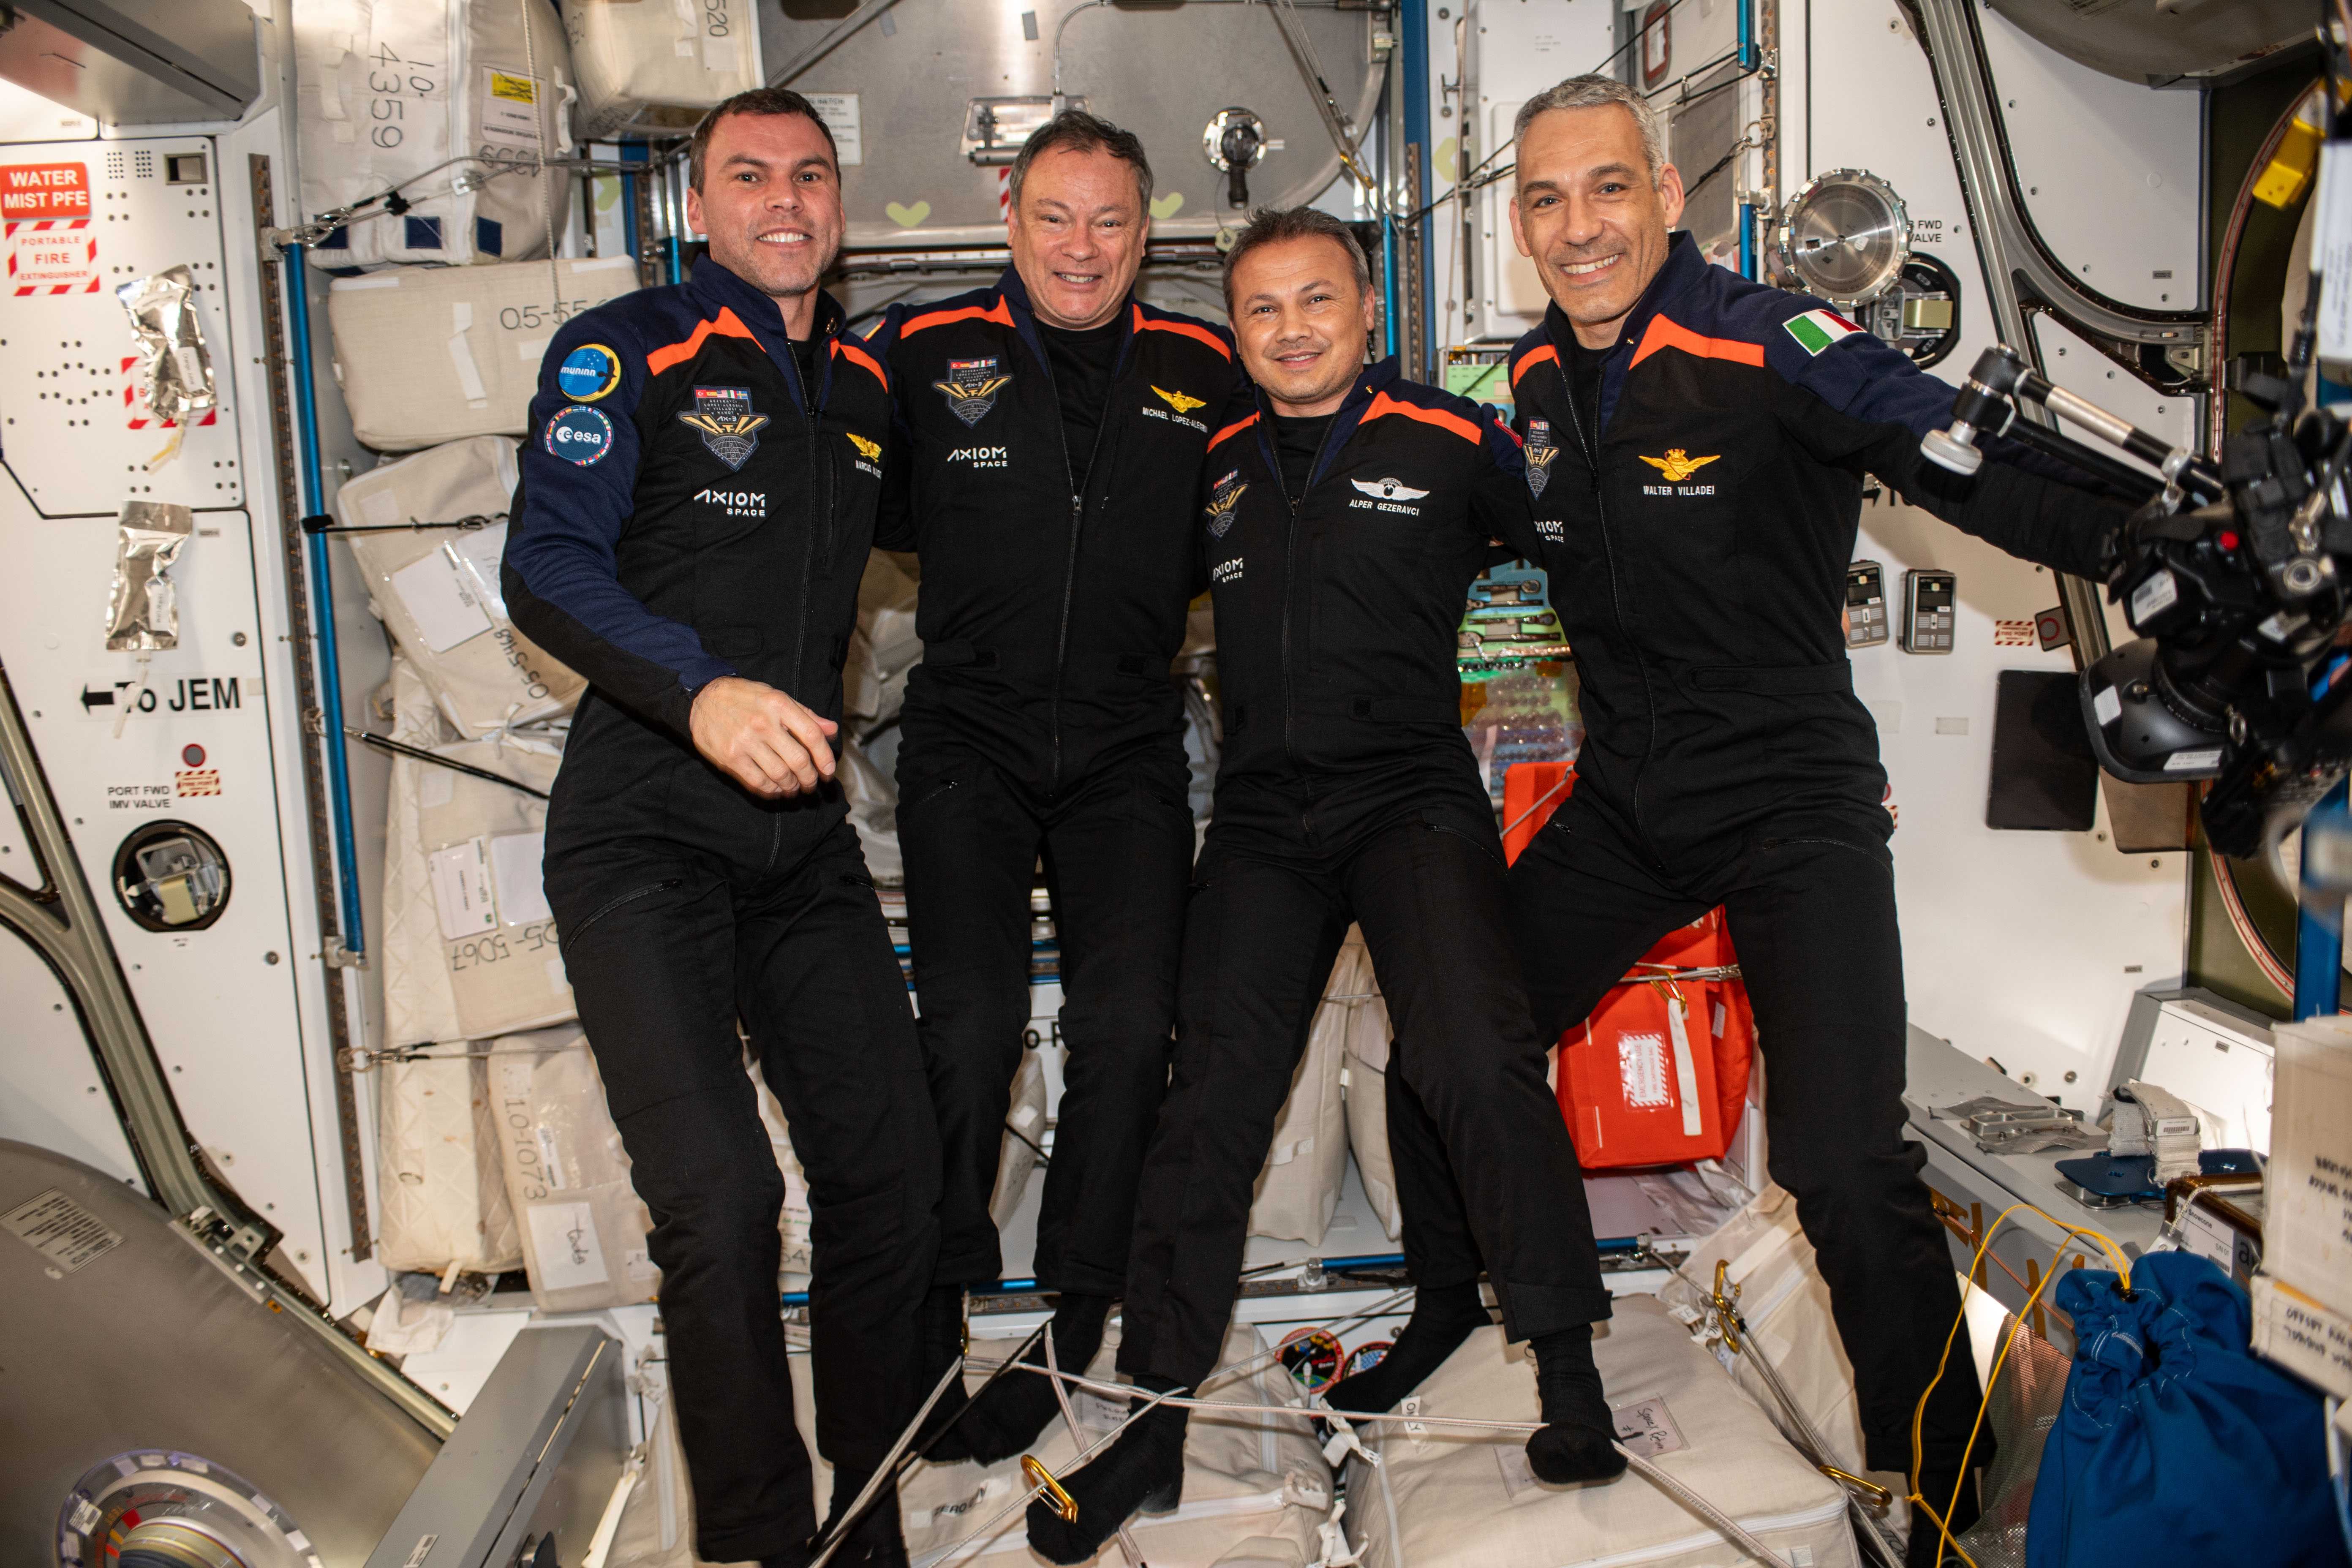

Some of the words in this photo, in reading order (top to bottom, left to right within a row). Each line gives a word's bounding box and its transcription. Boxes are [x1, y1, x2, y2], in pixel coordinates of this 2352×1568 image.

[369, 41, 403, 148] 4359
[10, 170, 78, 187] WATER
[4, 193, 47, 209] MIST
[53, 191, 88, 207] PFE
[1918, 220, 1942, 230] FWD
[21, 236, 81, 245] PORTABLE
[35, 253, 70, 264] FIRE
[20, 270, 87, 280] EXTINGUISHER
[560, 366, 596, 377] muninn
[1142, 407, 1169, 420] MICHAEL
[947, 446, 1007, 462] AXIOM
[1643, 486, 1671, 495] WALTER
[1677, 486, 1714, 496] VILLADEI
[694, 489, 765, 507] AXIOM
[727, 508, 765, 516] SPACE
[1349, 499, 1372, 509] ALPER
[1377, 503, 1419, 516] GEZERAVCI
[1535, 521, 1563, 534] XIOM
[1222, 572, 1242, 583] SPACE
[169, 678, 241, 711] JEM
[108, 786, 139, 796] PORT
[144, 785, 170, 795] FWD
[109, 800, 129, 808] IMV
[133, 799, 171, 808] VALVE
[1634, 1044, 1642, 1056] USE
[1636, 1059, 1646, 1097] EMERGENCY
[2188, 1209, 2213, 1228] Snowcone
[2215, 1243, 2224, 1252] S/N
